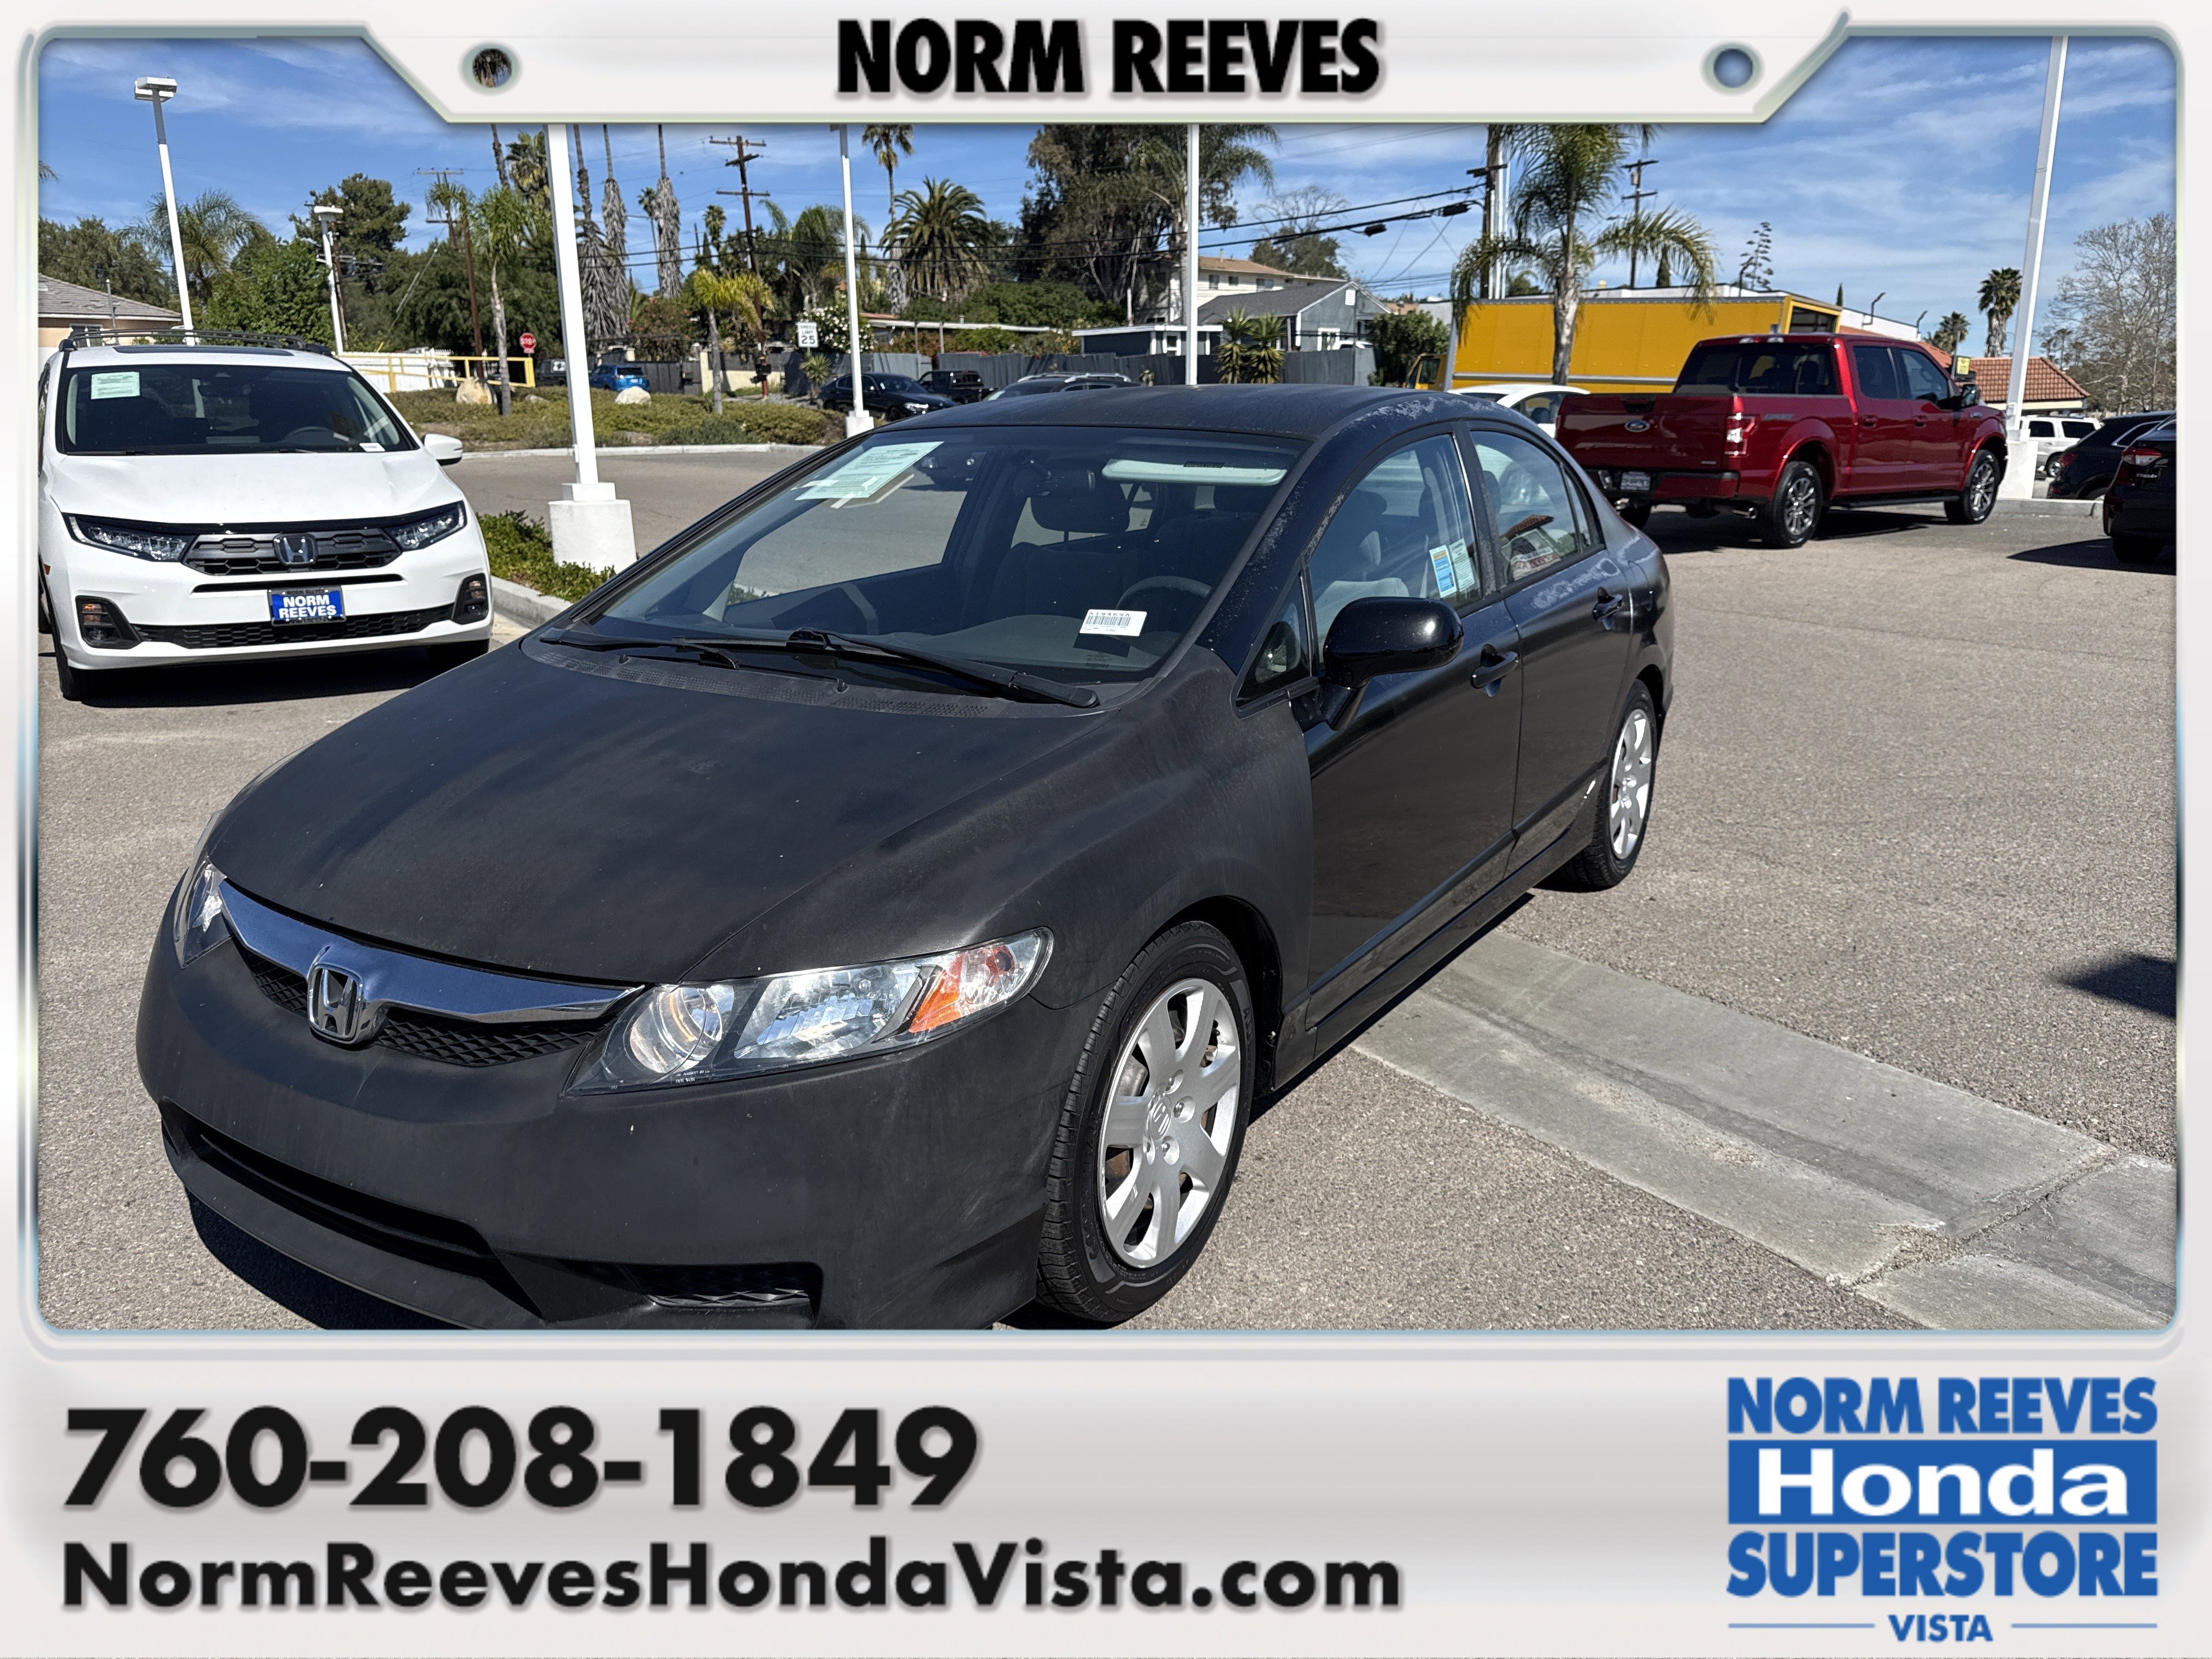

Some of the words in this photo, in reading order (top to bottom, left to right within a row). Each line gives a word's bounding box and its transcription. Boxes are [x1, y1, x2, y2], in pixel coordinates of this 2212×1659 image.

[801, 335, 816, 345] 25
[283, 595, 330, 607] NORM
[279, 605, 337, 618] REEVES
